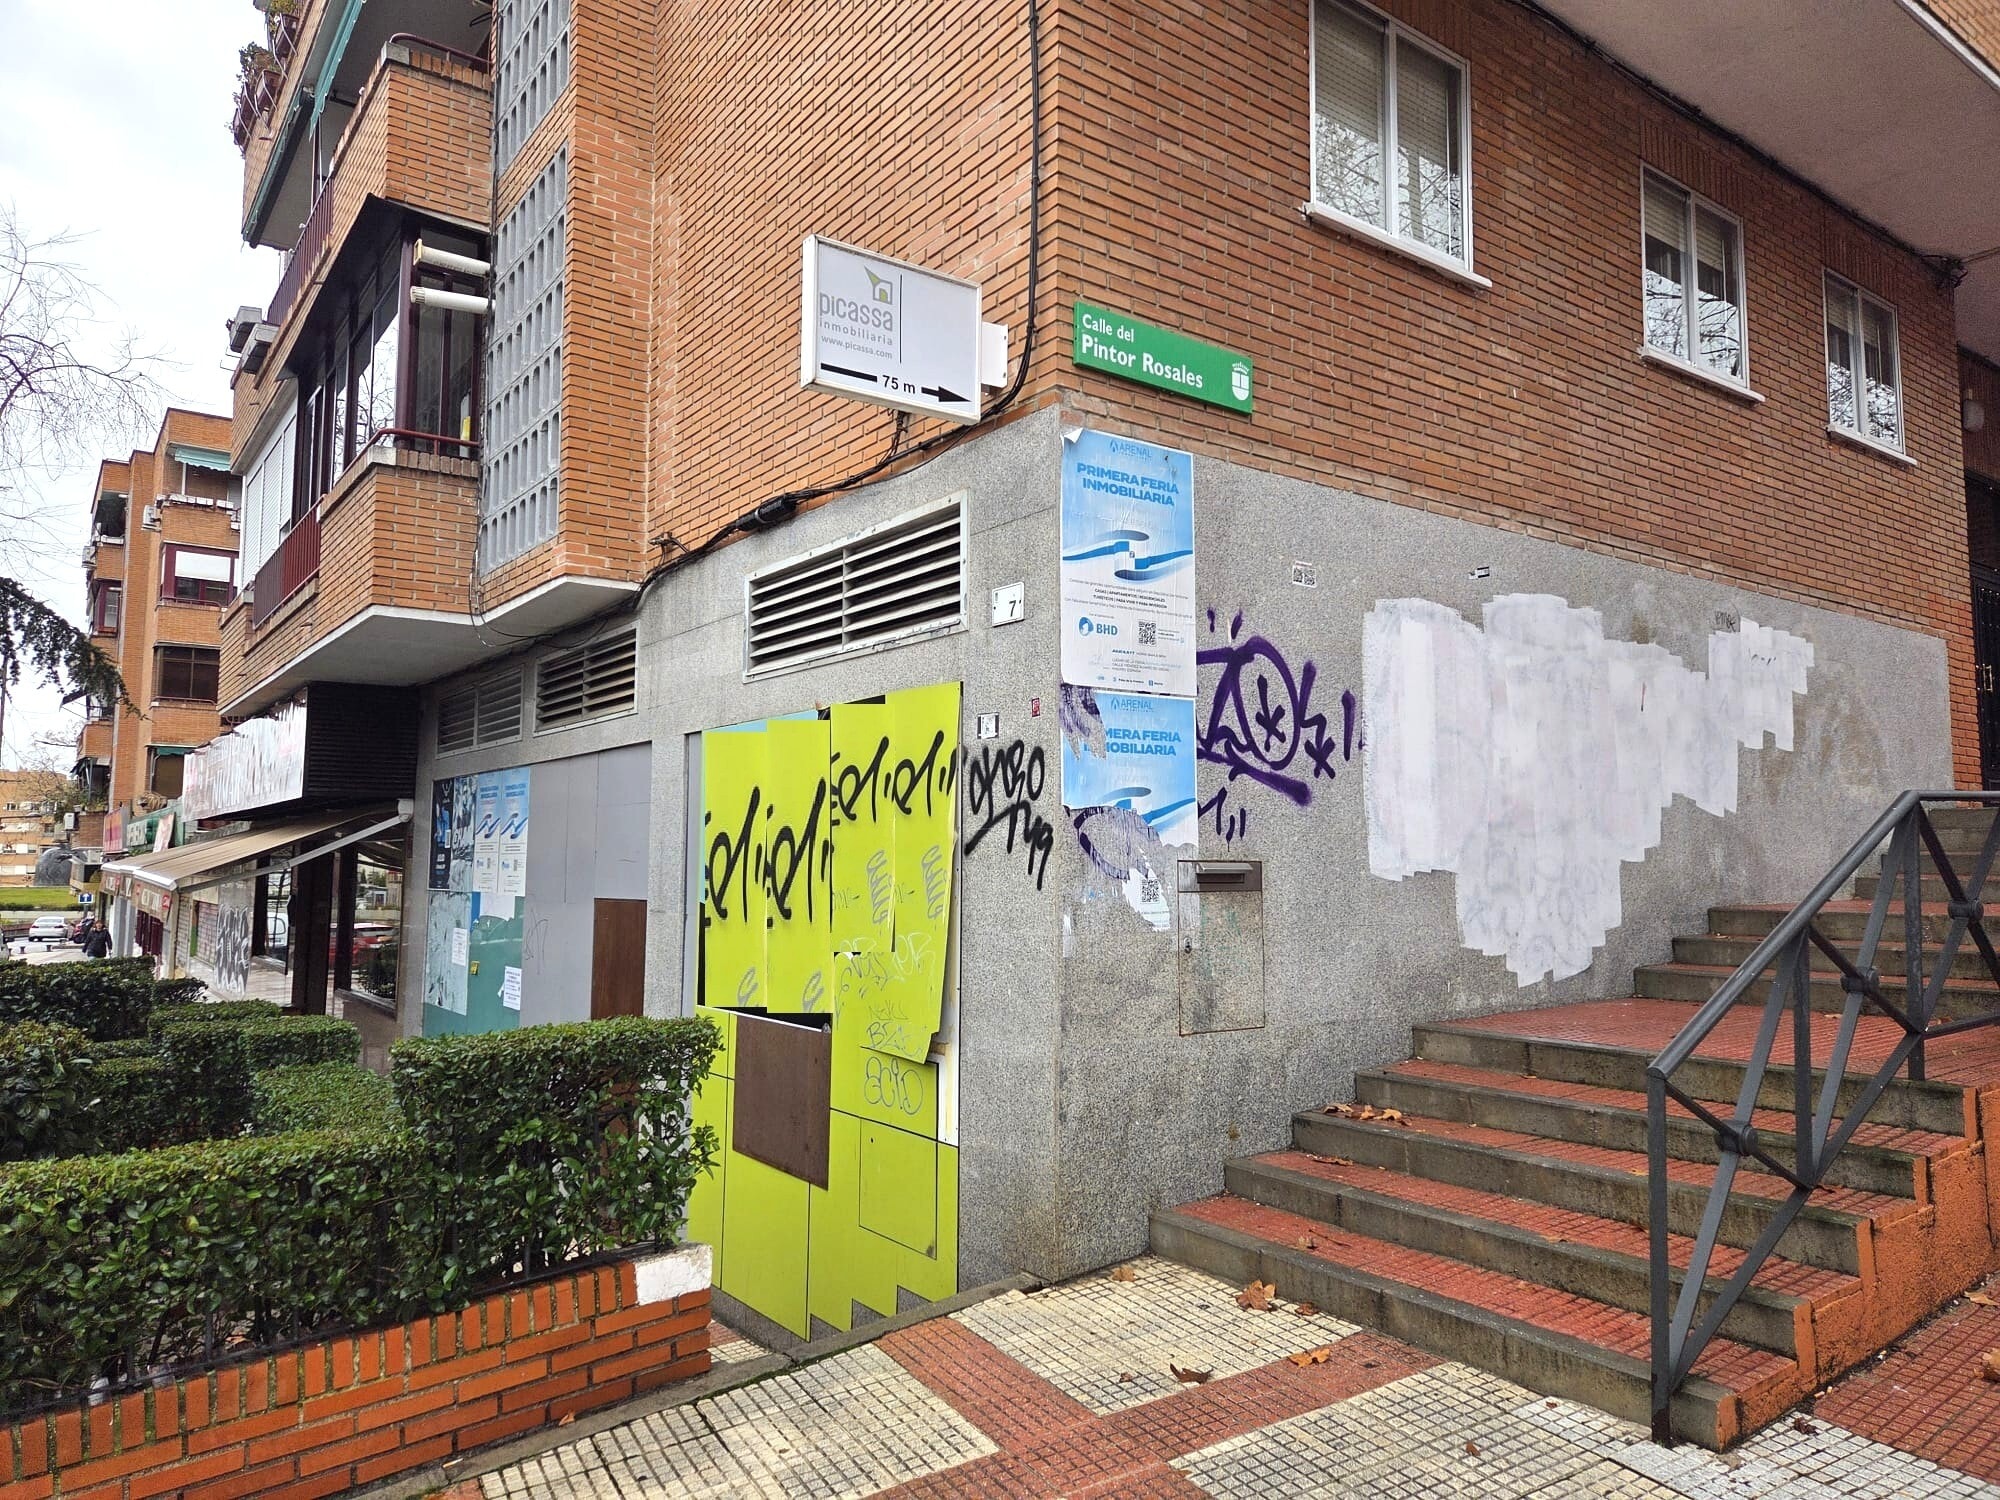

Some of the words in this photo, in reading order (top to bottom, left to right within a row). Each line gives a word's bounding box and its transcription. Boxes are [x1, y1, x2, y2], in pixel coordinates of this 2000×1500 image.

[820, 292, 893, 331] picassa
[819, 319, 893, 345] inmobiliaria
[1082, 314, 1112, 336] Calle
[1117, 325, 1134, 342] del
[821, 335, 893, 359] www.picassa.com
[1082, 334, 1136, 367] Pintor
[1142, 353, 1203, 388] Rosales
[882, 375, 899, 390] 75
[903, 383, 916, 394] m
[1119, 442, 1152, 458] ARENAL
[1076, 462, 1139, 488] PRIMERA
[1140, 477, 1179, 495] FERIA
[1082, 477, 1175, 506] INMOBILIARIA
[1008, 600, 1017, 617] 7
[1096, 623, 1118, 636] BHD
[1120, 698, 1153, 710] ARENAL
[1142, 730, 1181, 743] FERIA
